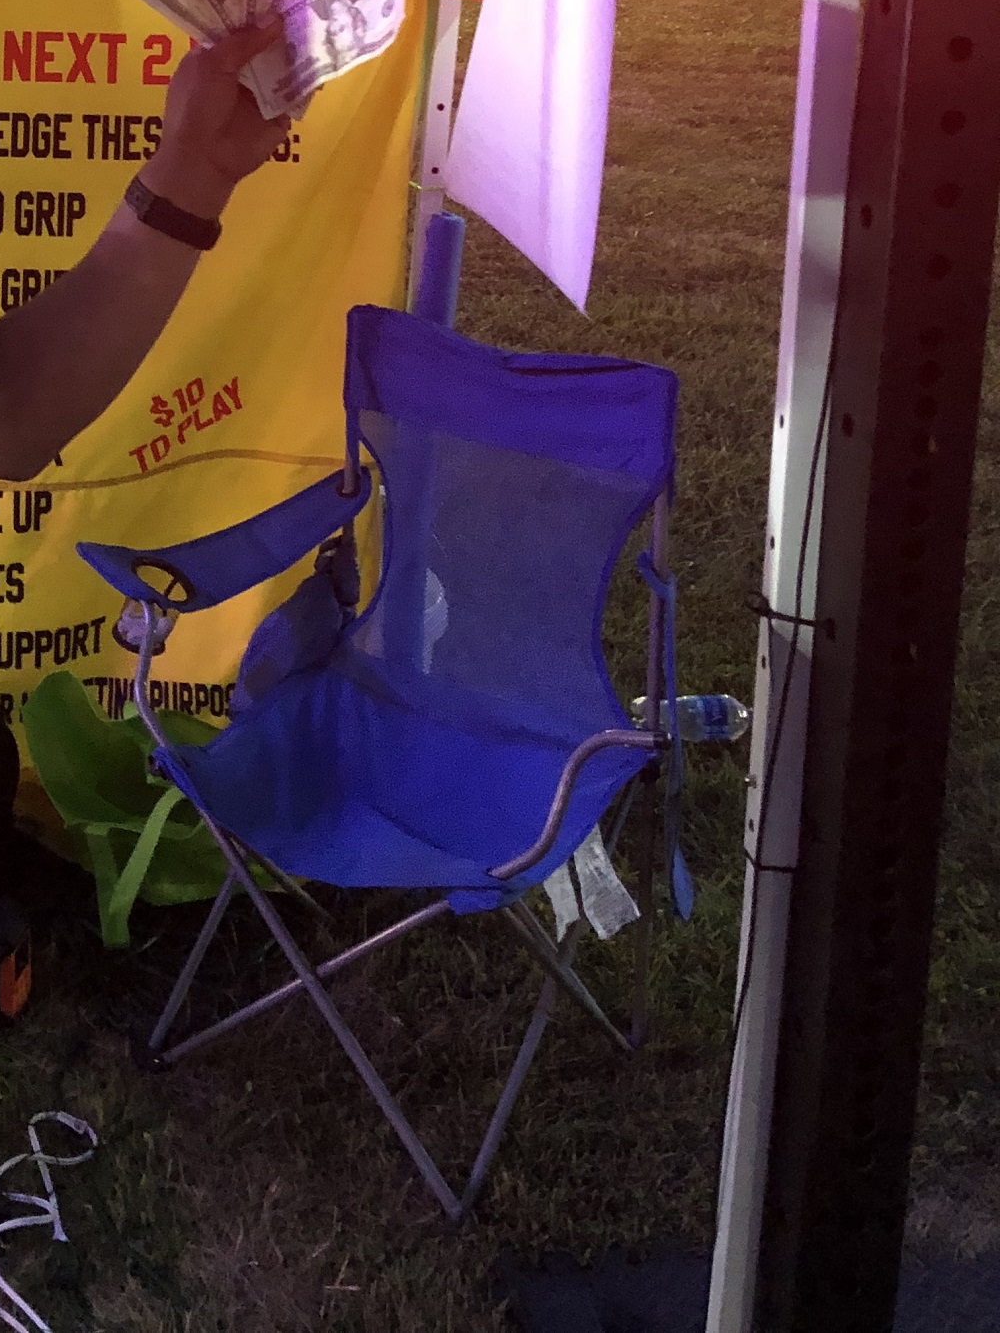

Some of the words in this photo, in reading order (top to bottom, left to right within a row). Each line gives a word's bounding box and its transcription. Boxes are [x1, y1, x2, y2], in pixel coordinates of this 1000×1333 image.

[3, 31, 127, 84] NEXT
[142, 34, 172, 85] 2
[82, 114, 163, 160] THES
[14, 191, 86, 236] GRIP
[1, 268, 71, 313] GR
[150, 377, 206, 427] $10
[177, 376, 243, 444] PLAY
[13, 490, 52, 533] UP
